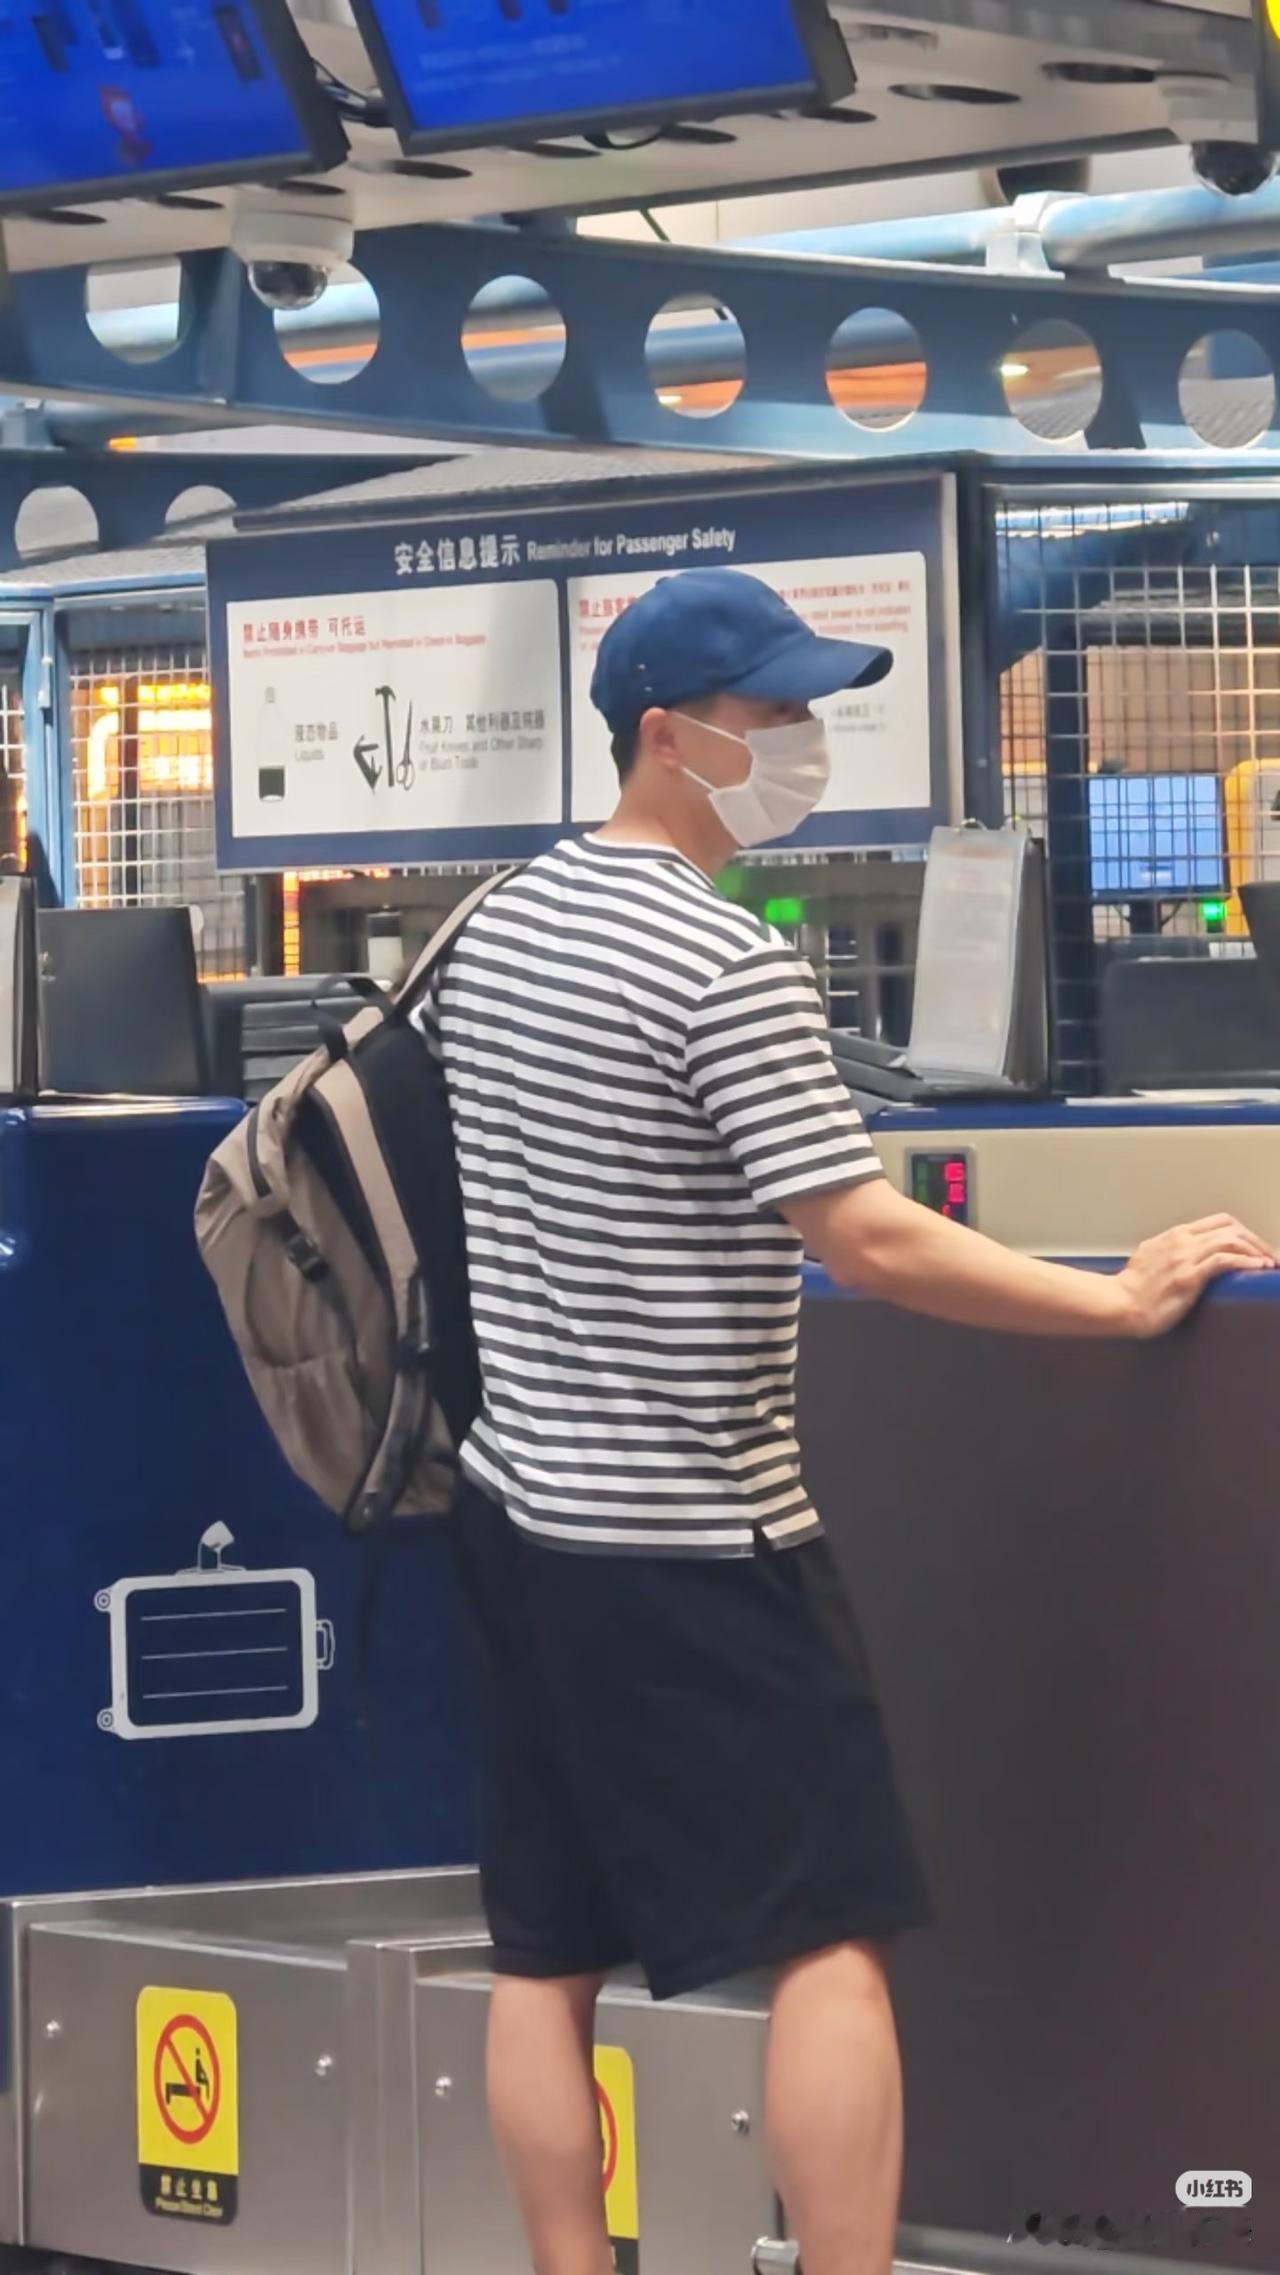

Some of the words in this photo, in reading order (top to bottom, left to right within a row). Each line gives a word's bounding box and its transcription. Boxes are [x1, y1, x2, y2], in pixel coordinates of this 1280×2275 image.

[394, 533, 521, 576] 安全信息提示
[527, 537, 591, 562] Reminder
[594, 535, 613, 556] for
[616, 533, 689, 556] Passenger
[691, 526, 736, 552] Safety
